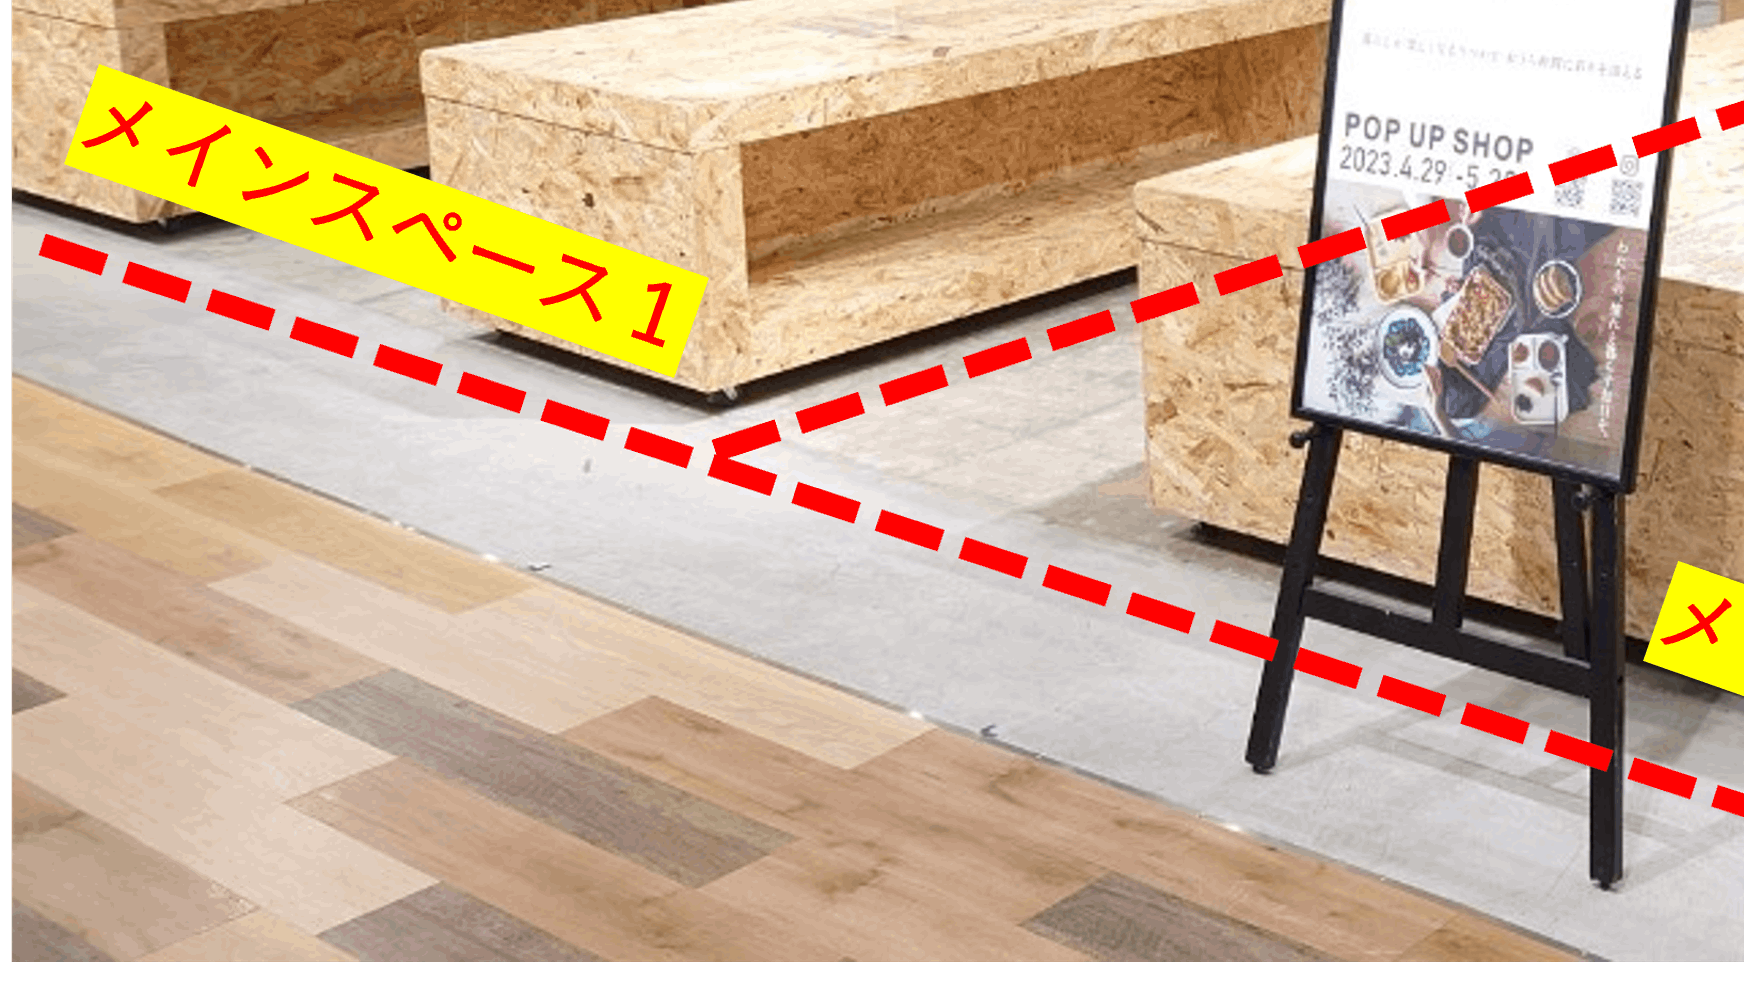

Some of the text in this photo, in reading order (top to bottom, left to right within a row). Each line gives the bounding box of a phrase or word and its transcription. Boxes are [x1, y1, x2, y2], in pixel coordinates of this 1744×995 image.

[1345, 112, 1534, 164] POP UP SHOP
